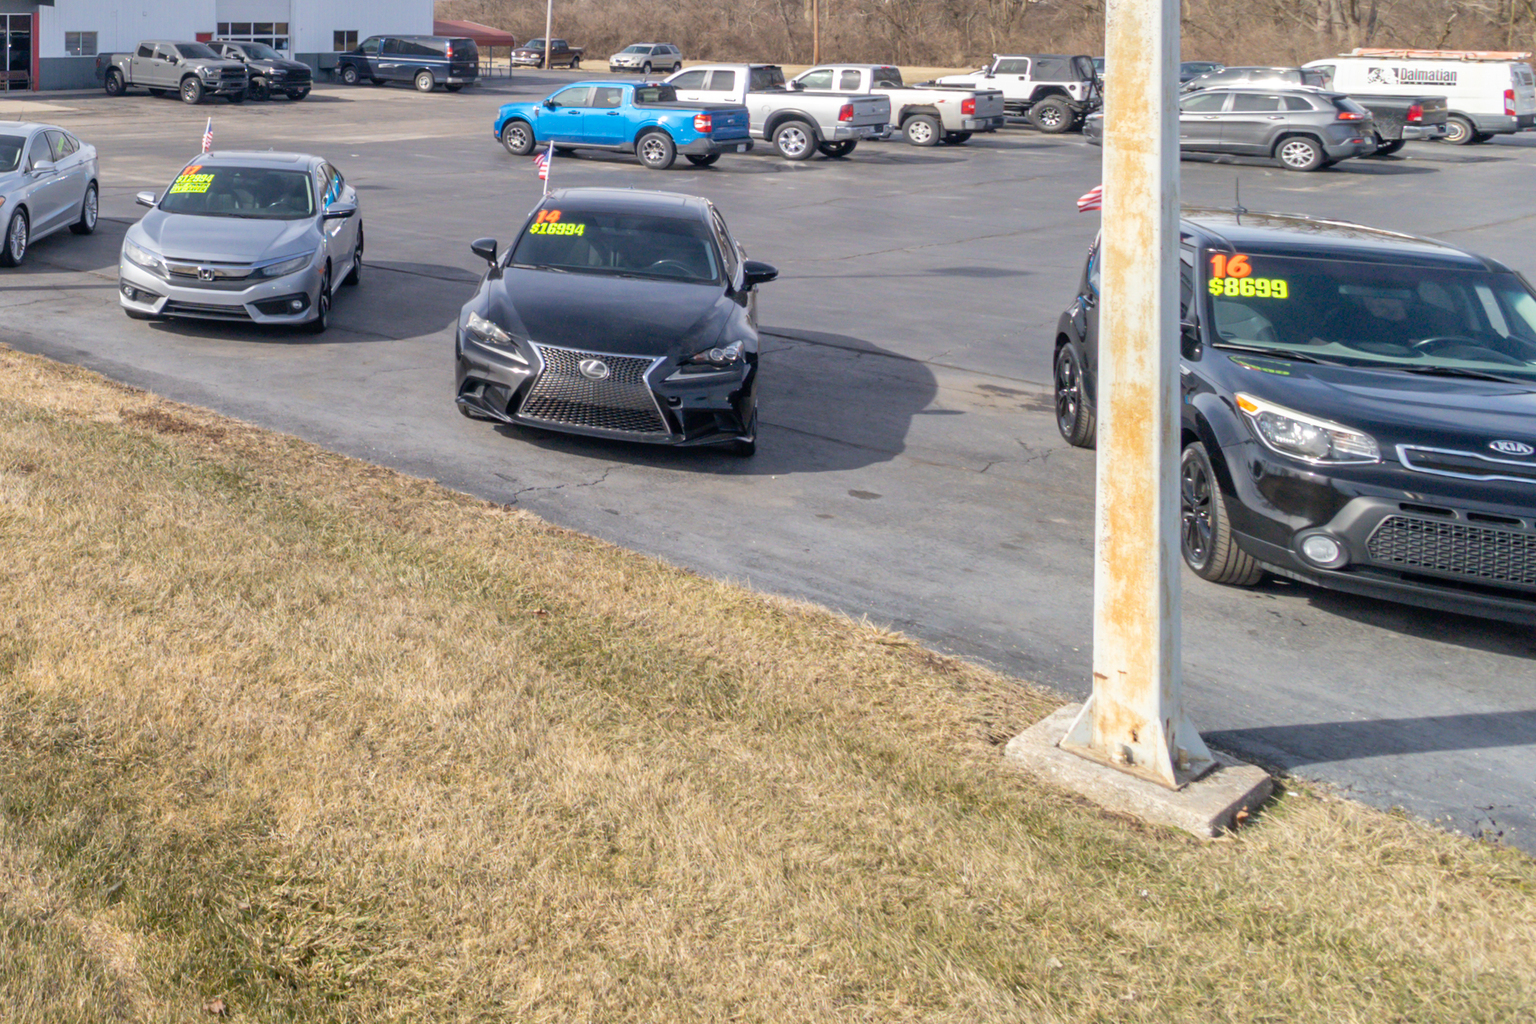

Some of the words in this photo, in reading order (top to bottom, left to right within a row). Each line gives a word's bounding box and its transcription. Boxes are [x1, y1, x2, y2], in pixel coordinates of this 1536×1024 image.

[1400, 67, 1457, 82] Dalmatian
[182, 164, 203, 176] 17
[536, 209, 562, 224] 14
[529, 222, 586, 236] $16994
[1210, 254, 1252, 279] 16
[1208, 277, 1289, 299] $8699
